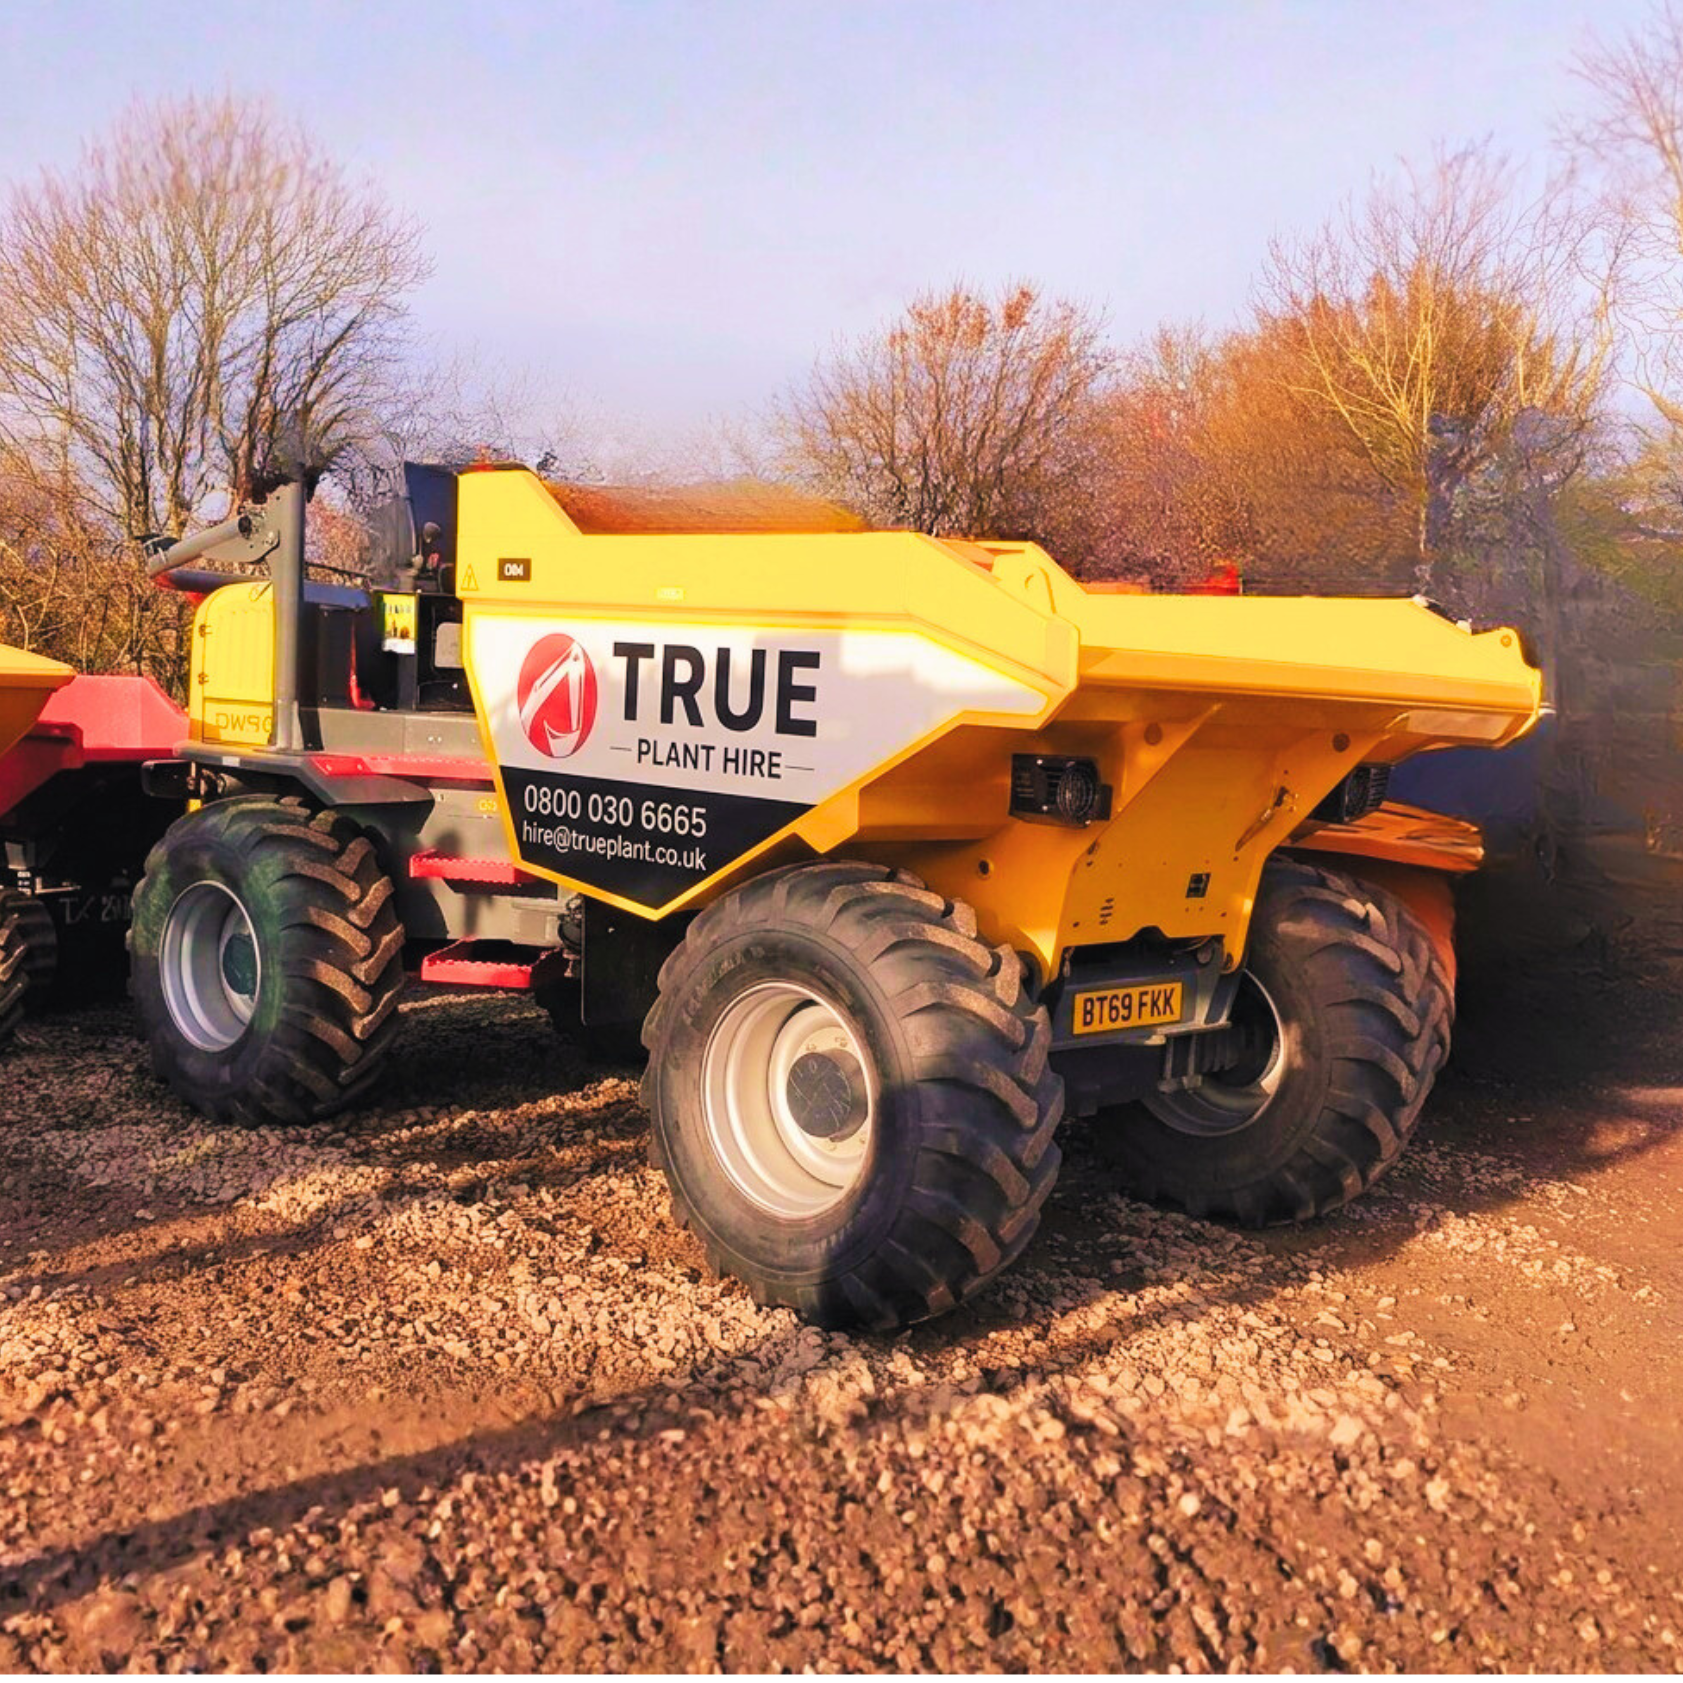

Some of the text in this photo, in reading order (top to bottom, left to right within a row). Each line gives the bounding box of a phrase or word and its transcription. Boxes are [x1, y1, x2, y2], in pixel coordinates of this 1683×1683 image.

[613, 641, 821, 738] TRUE
[637, 738, 783, 779] PLANT HIRE
[524, 784, 707, 838] 0800 030 6665
[522, 820, 707, 871] hire@trueplant.co.uk
[1082, 987, 1176, 1027] BT69 FKK
